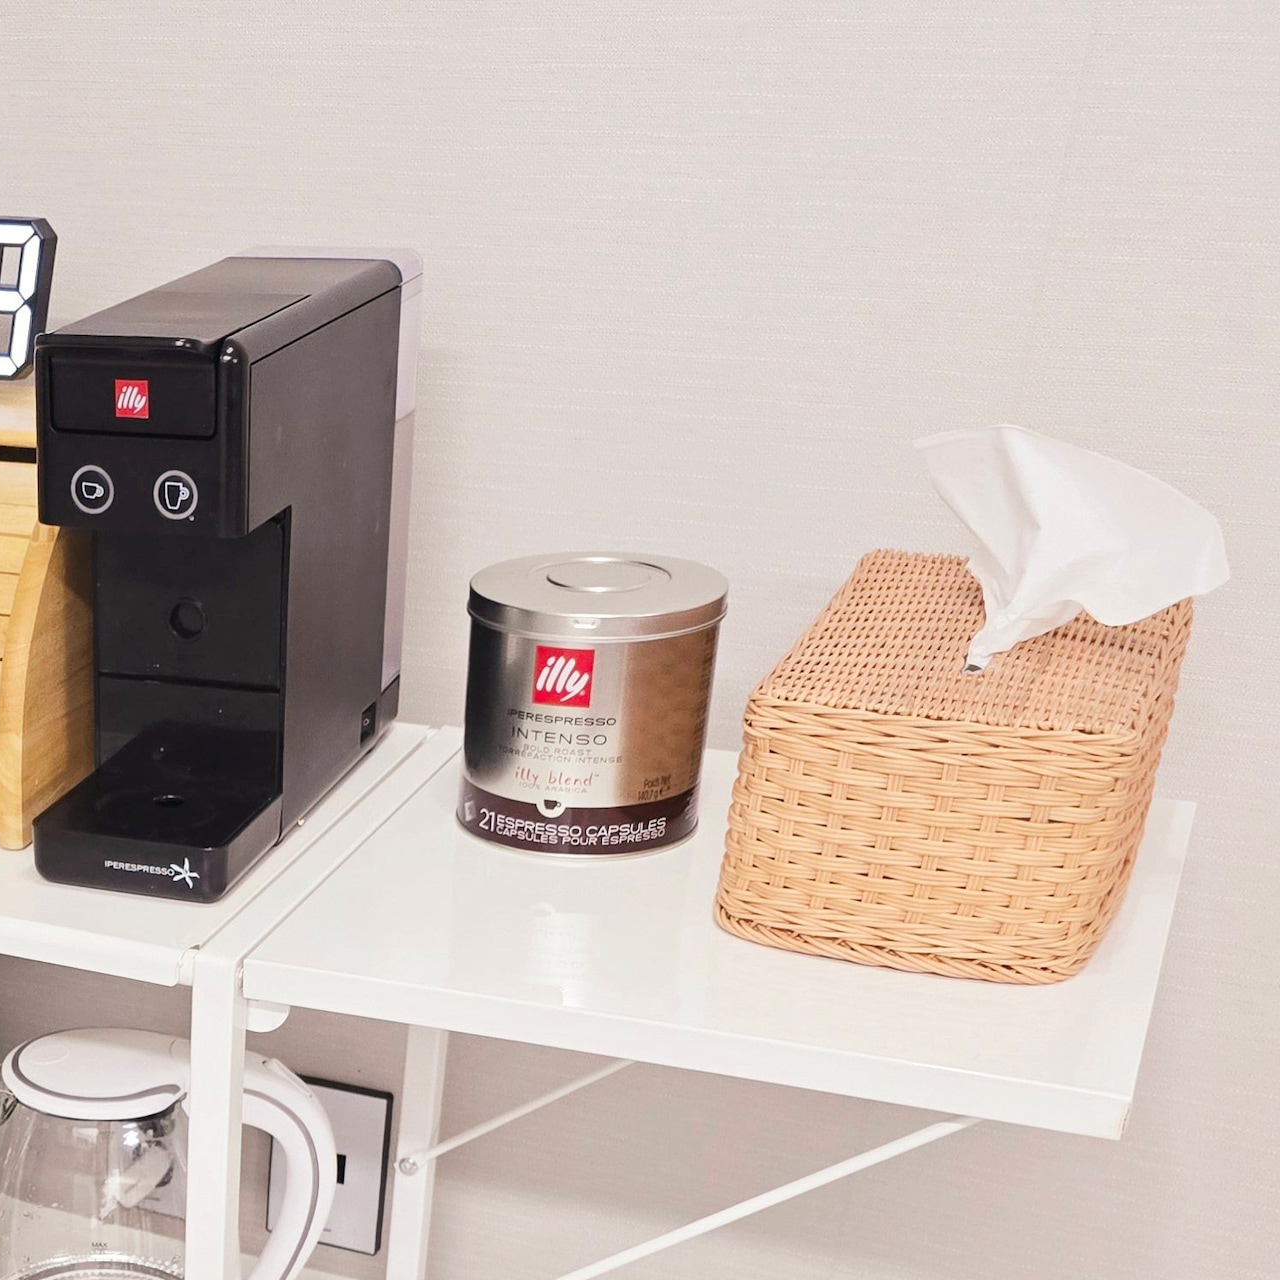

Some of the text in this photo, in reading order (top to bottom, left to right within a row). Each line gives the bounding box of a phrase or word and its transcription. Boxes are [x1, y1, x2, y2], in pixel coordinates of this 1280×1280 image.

[117, 385, 147, 414] illy
[535, 655, 590, 703] illy
[507, 708, 617, 727] IPERESPRESSO
[511, 725, 608, 746] INTENSO
[523, 743, 593, 756] BOLD ROAST
[575, 755, 623, 764] INTENSE
[514, 766, 594, 786] illy blend
[479, 808, 667, 837] 21 ESPRESSO CAPSULES
[495, 825, 666, 846] CAPSULES POUR ESPRESSO
[104, 860, 176, 877] IPERESPRESSO
